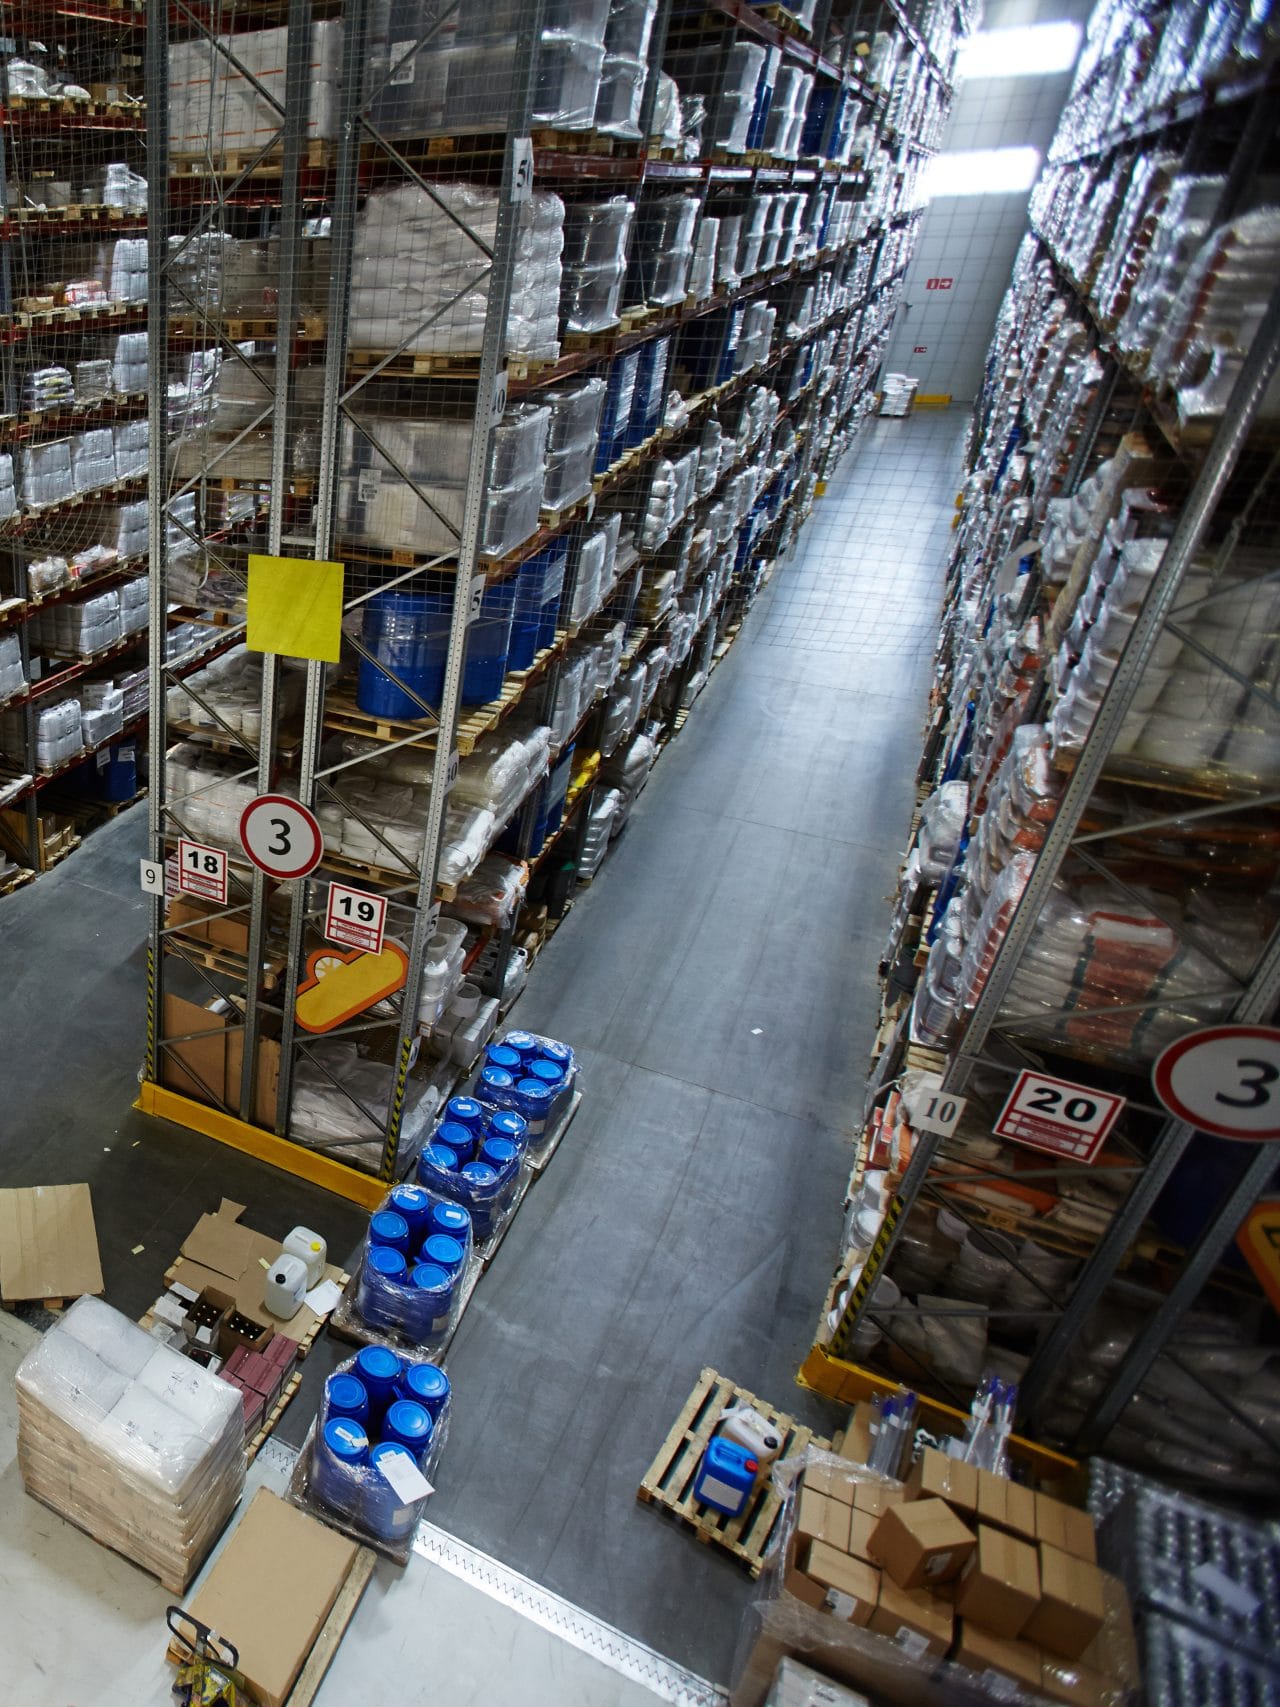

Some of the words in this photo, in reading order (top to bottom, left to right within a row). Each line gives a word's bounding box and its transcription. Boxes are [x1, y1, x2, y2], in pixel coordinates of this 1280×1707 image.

[268, 818, 292, 856] 3
[188, 850, 218, 874] 18
[145, 868, 156, 884] 9
[339, 896, 375, 922] 19
[1215, 1058, 1280, 1108] 3
[924, 1097, 957, 1124] 10
[1026, 1087, 1098, 1123] 20
